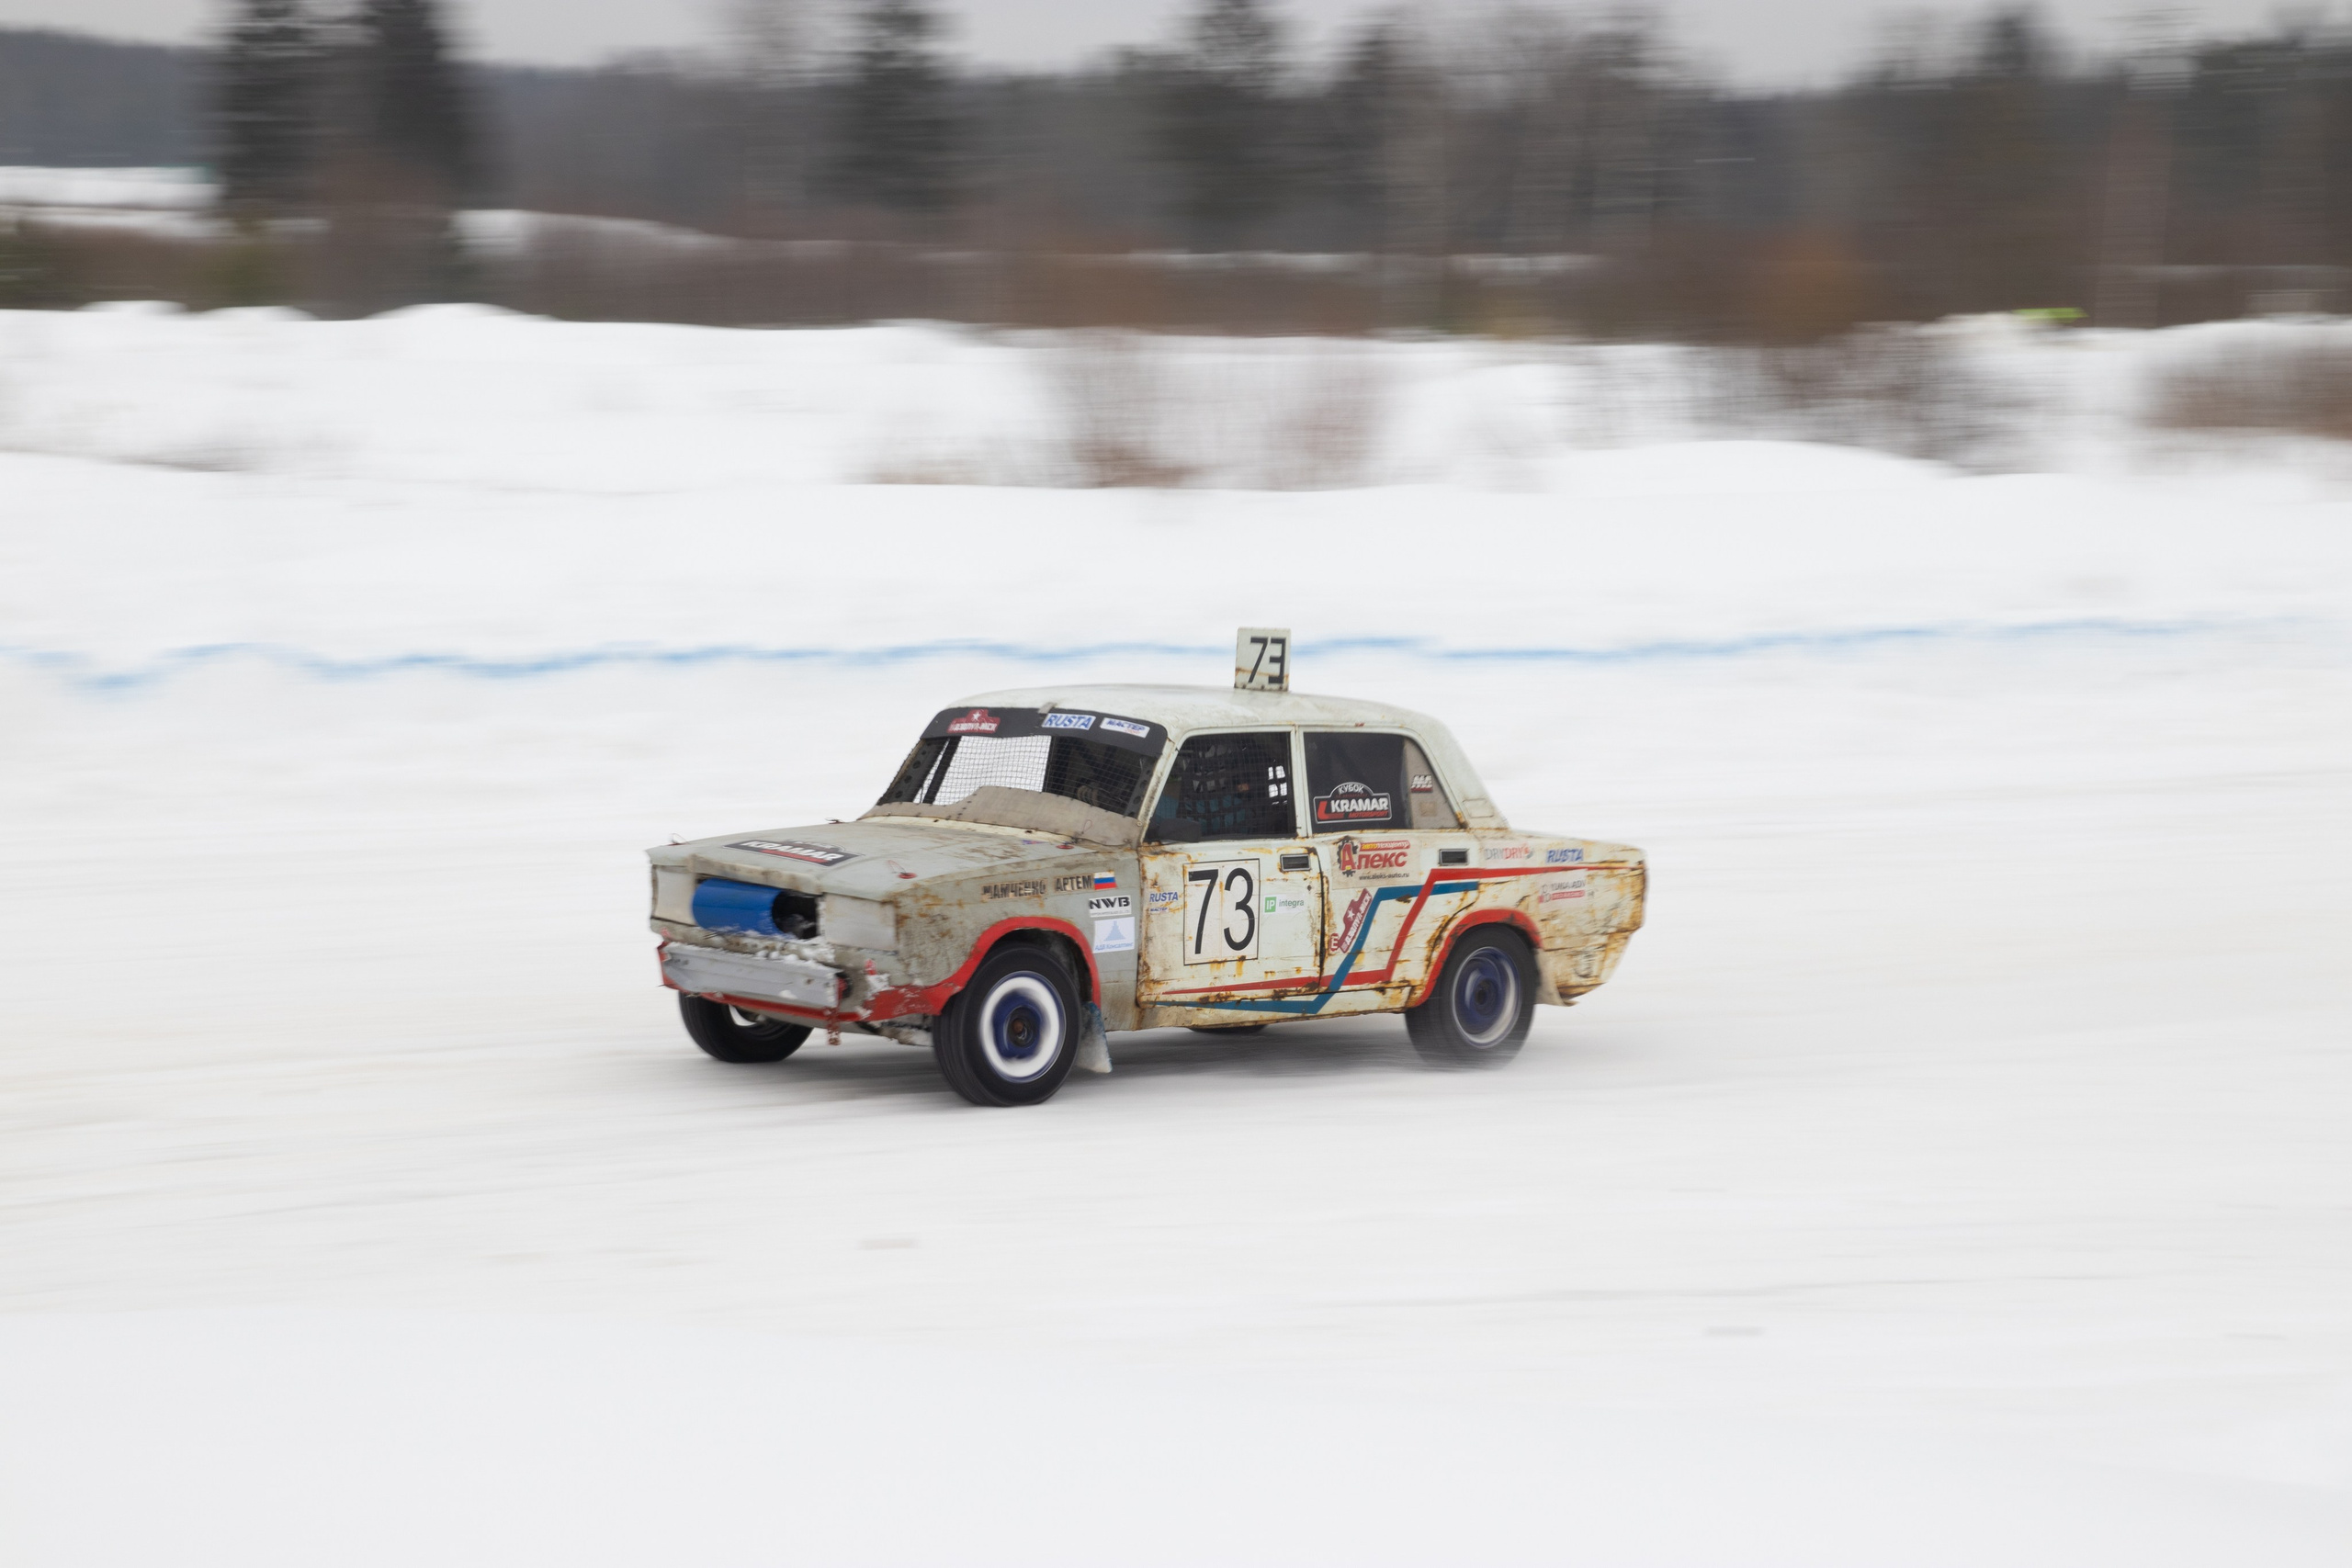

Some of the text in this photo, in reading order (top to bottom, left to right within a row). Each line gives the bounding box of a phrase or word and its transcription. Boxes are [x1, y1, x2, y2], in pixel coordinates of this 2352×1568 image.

[1248, 637, 1286, 684] 73
[1046, 714, 1094, 730] RUSTA
[1338, 784, 1365, 795] КУБОК
[1330, 797, 1389, 813] KRAMAR
[740, 840, 844, 862] KRAMAR
[1340, 842, 1408, 871] Алекс
[1485, 846, 1524, 861] DRYDRY
[1546, 848, 1584, 863] RUSTA
[1056, 874, 1092, 892] АРТЕМ
[1089, 897, 1130, 909] NWB
[1149, 892, 1179, 902] RUSTA
[1278, 898, 1305, 909] integra
[1188, 867, 1256, 955] 73
